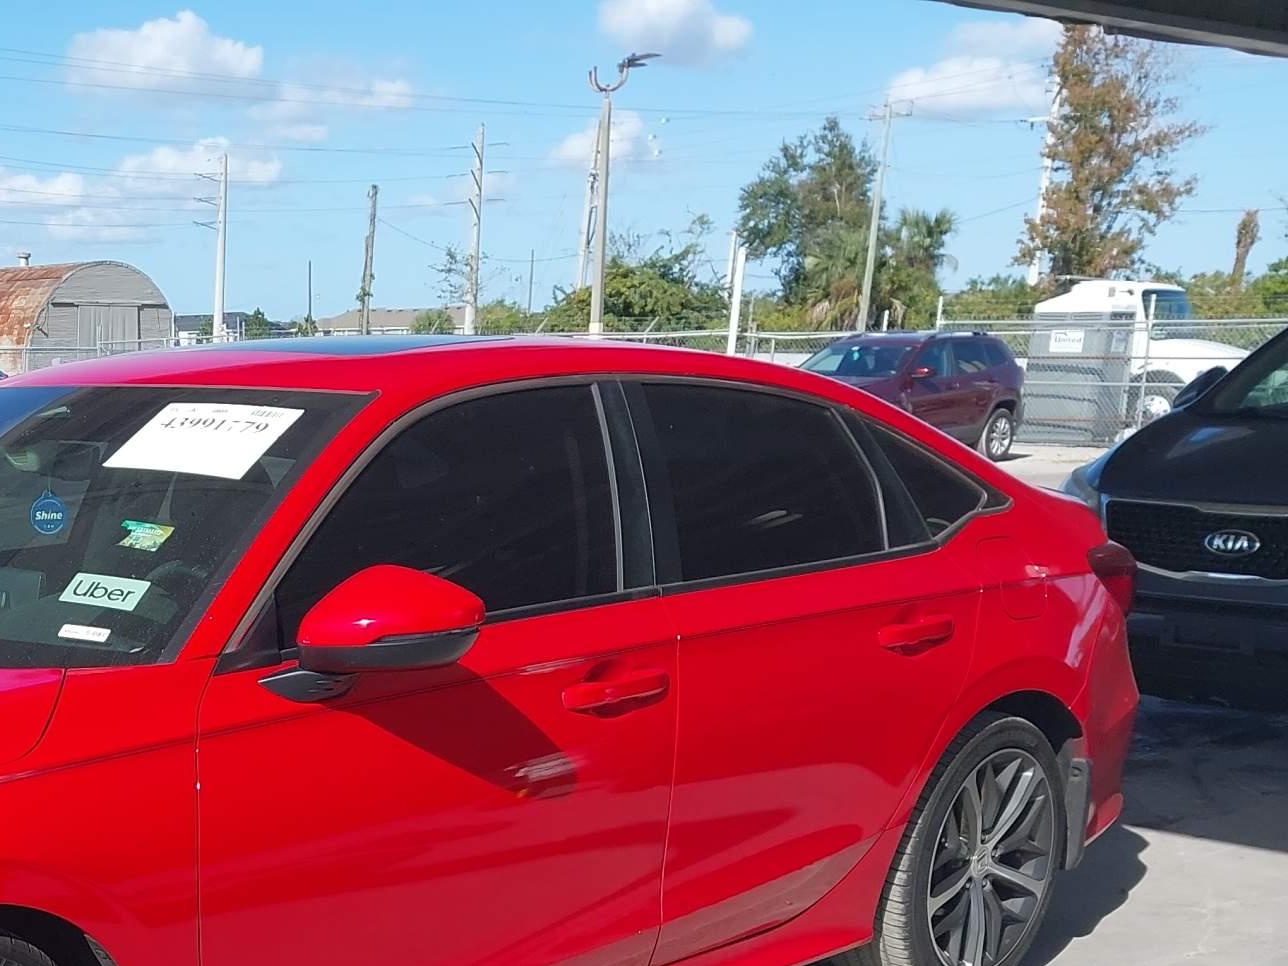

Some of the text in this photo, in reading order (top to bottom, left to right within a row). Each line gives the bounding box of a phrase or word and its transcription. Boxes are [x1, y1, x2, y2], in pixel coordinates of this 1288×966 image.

[34, 509, 63, 521] Shine
[1212, 534, 1249, 550] KIA
[72, 579, 136, 603] Uber
